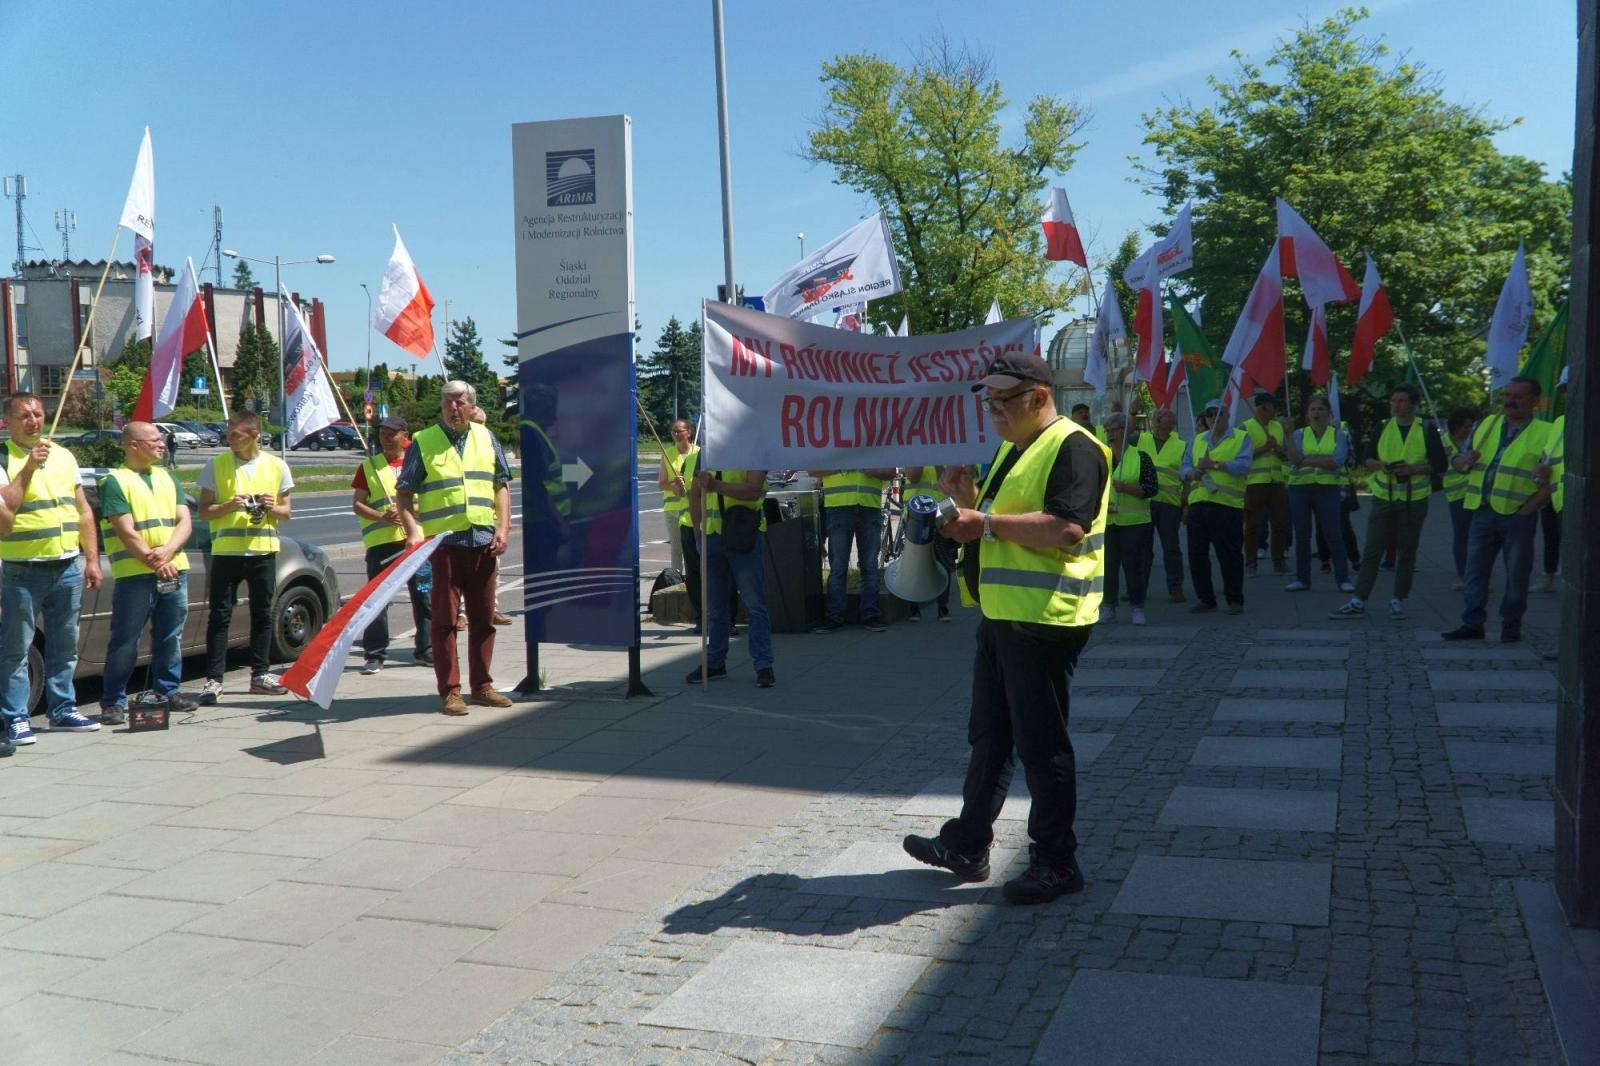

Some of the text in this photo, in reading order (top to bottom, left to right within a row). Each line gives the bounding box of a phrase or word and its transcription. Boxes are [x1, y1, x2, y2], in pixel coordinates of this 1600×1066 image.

[522, 211, 624, 228] Agencja Restrukturyzacji
[528, 228, 581, 240] Modernizacji
[583, 226, 624, 237] Rolnictwa
[559, 259, 587, 273] Śląski
[555, 274, 591, 286] Oddział
[548, 288, 600, 301] Regionalny
[730, 335, 773, 378] MY
[906, 340, 1025, 383] JESTEŚ
[781, 394, 968, 449] ROLNIKAMI
